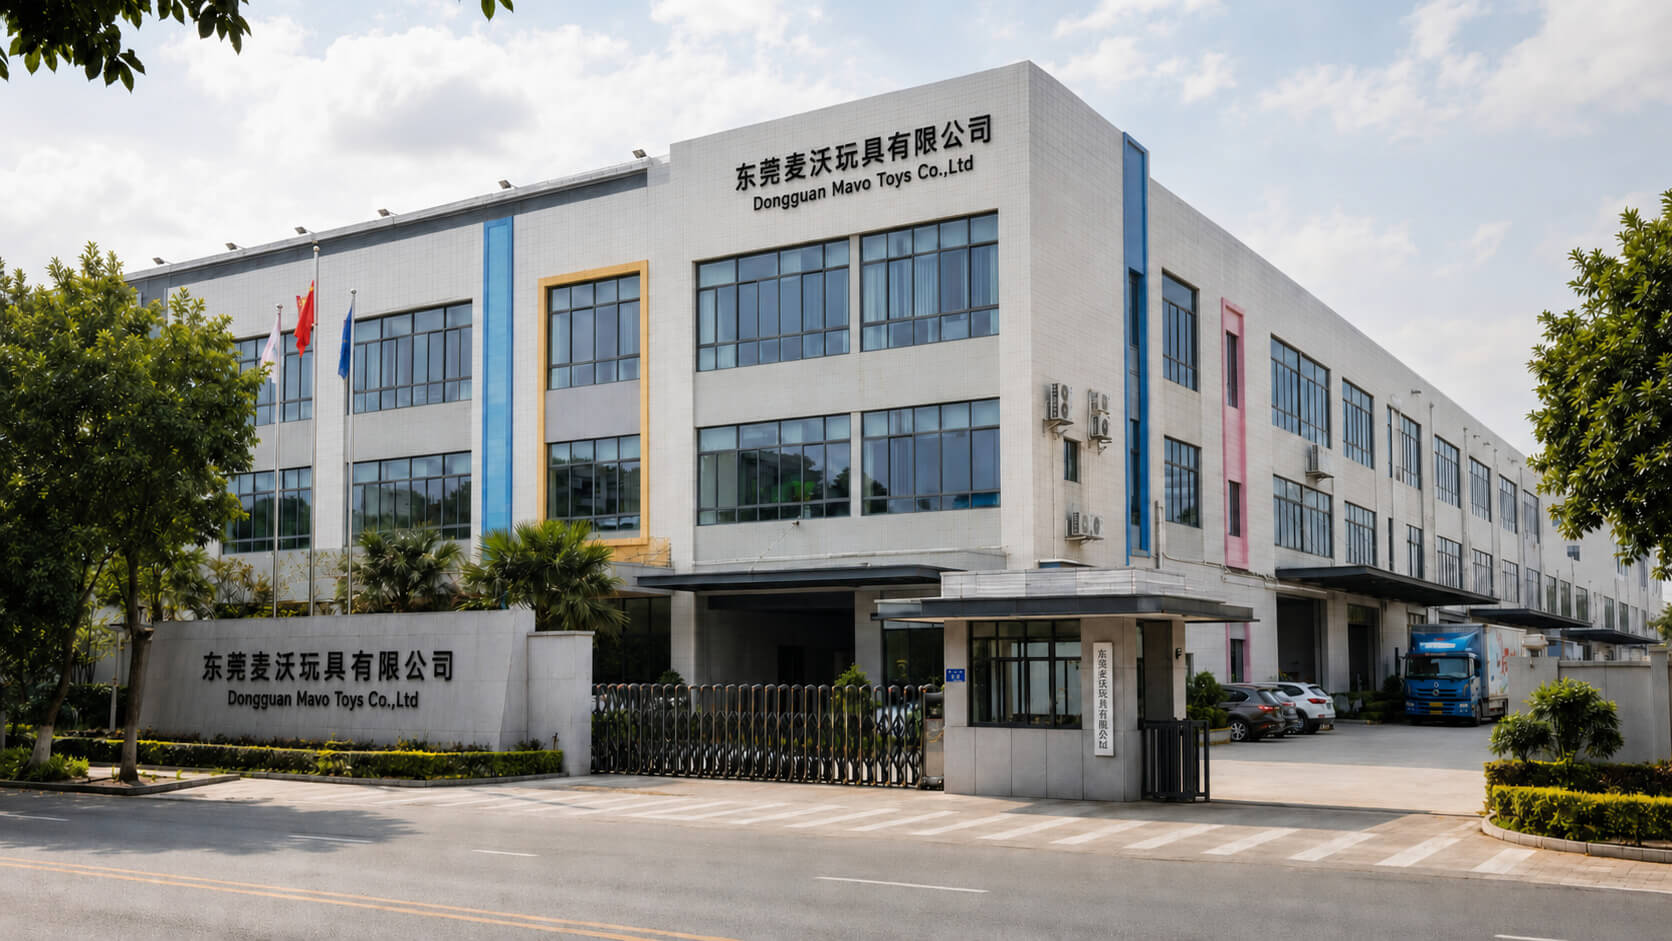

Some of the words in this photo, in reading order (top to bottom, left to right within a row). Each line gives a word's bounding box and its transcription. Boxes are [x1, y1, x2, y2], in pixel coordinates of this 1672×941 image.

[735, 114, 992, 192] 东莞麦沃玩具有限公司
[753, 185, 826, 212] Dongguan
[832, 177, 871, 197] Mavo
[877, 169, 912, 189] Toys
[917, 154, 974, 180] Co.,Ltd
[202, 649, 454, 682] 东莞麦沃玩具有限公司
[227, 689, 292, 710] Dongguan
[296, 690, 330, 707] Mavo
[334, 690, 364, 711] Toys
[368, 691, 419, 710] Co.,Ltd
